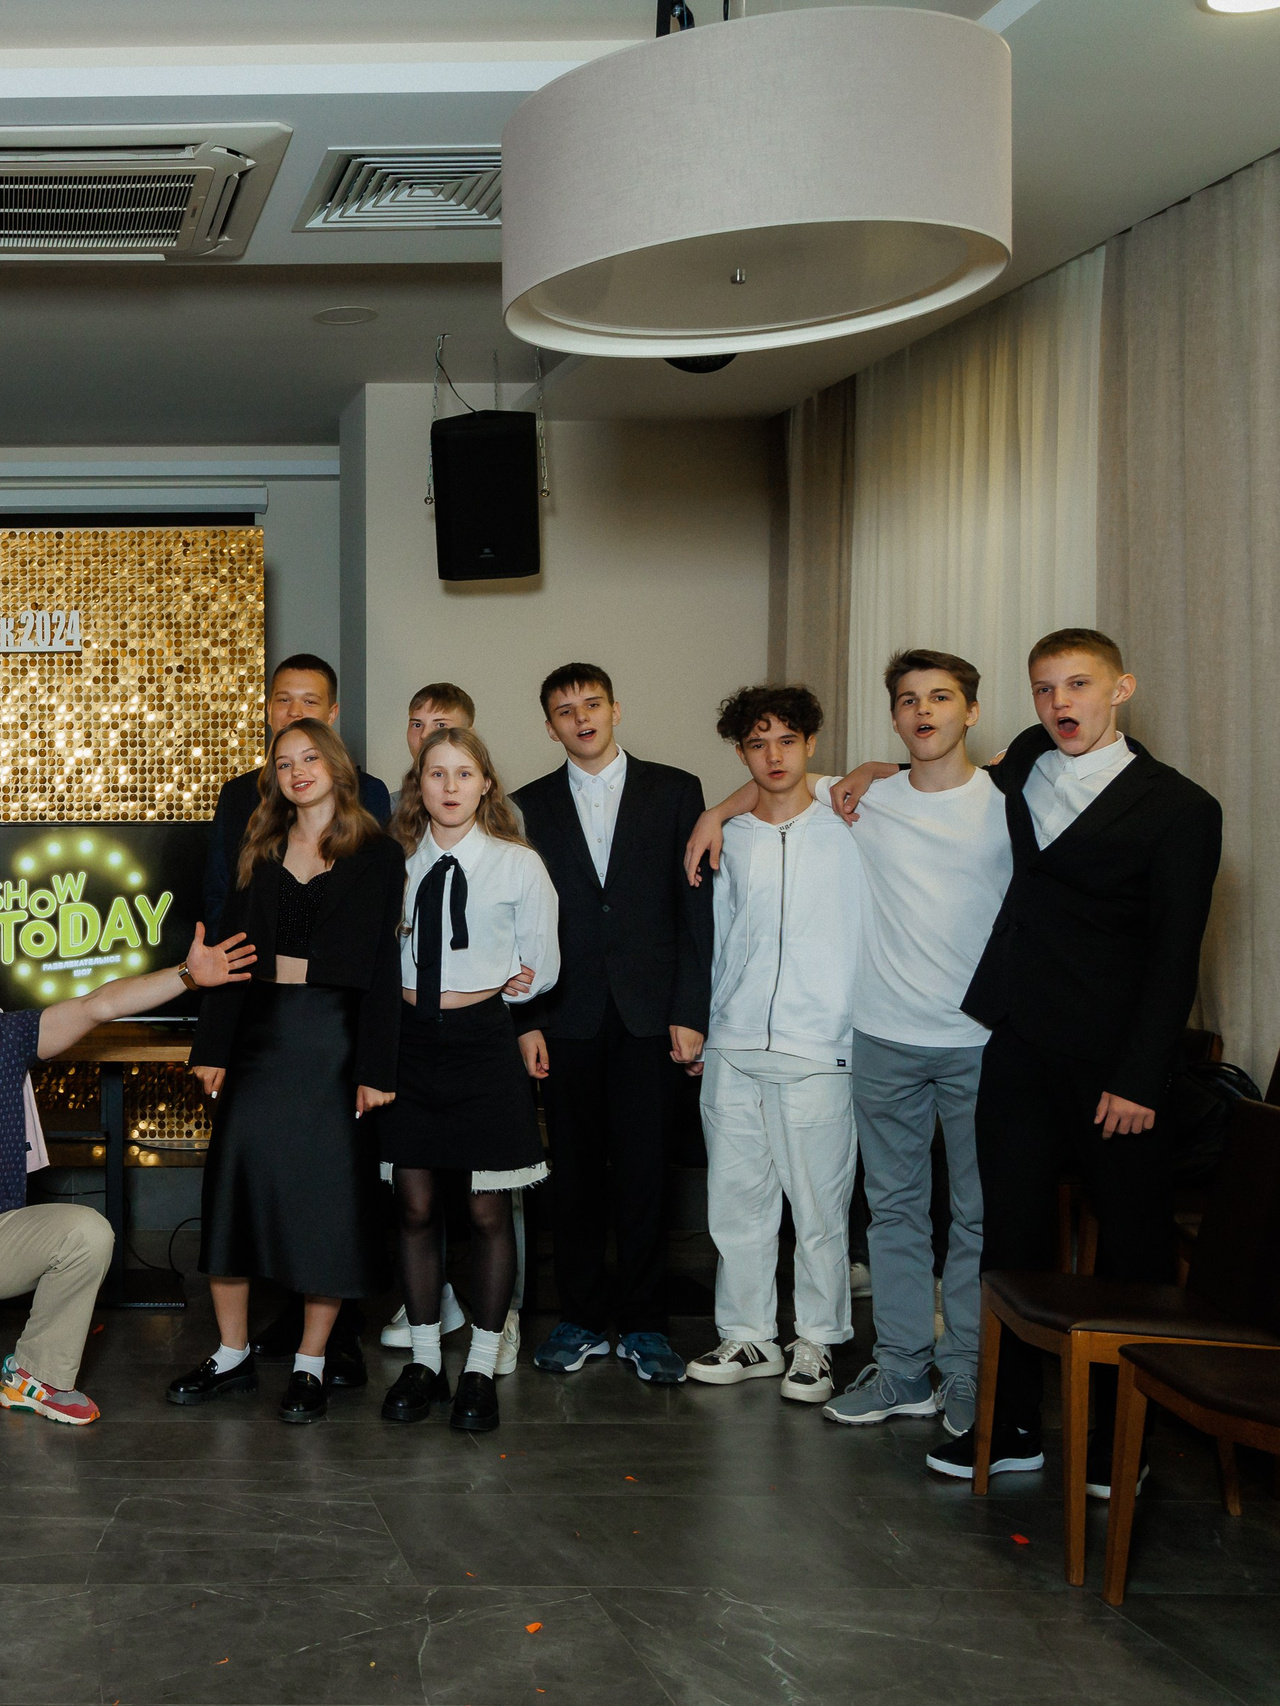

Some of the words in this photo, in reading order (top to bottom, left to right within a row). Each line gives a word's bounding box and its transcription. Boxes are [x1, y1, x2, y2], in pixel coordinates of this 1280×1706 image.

[20, 610, 82, 648] 2024
[42, 954, 121, 971] РАЗВЛЕКАТЕЛЬНОЕ
[73, 967, 92, 977] ШОУ
